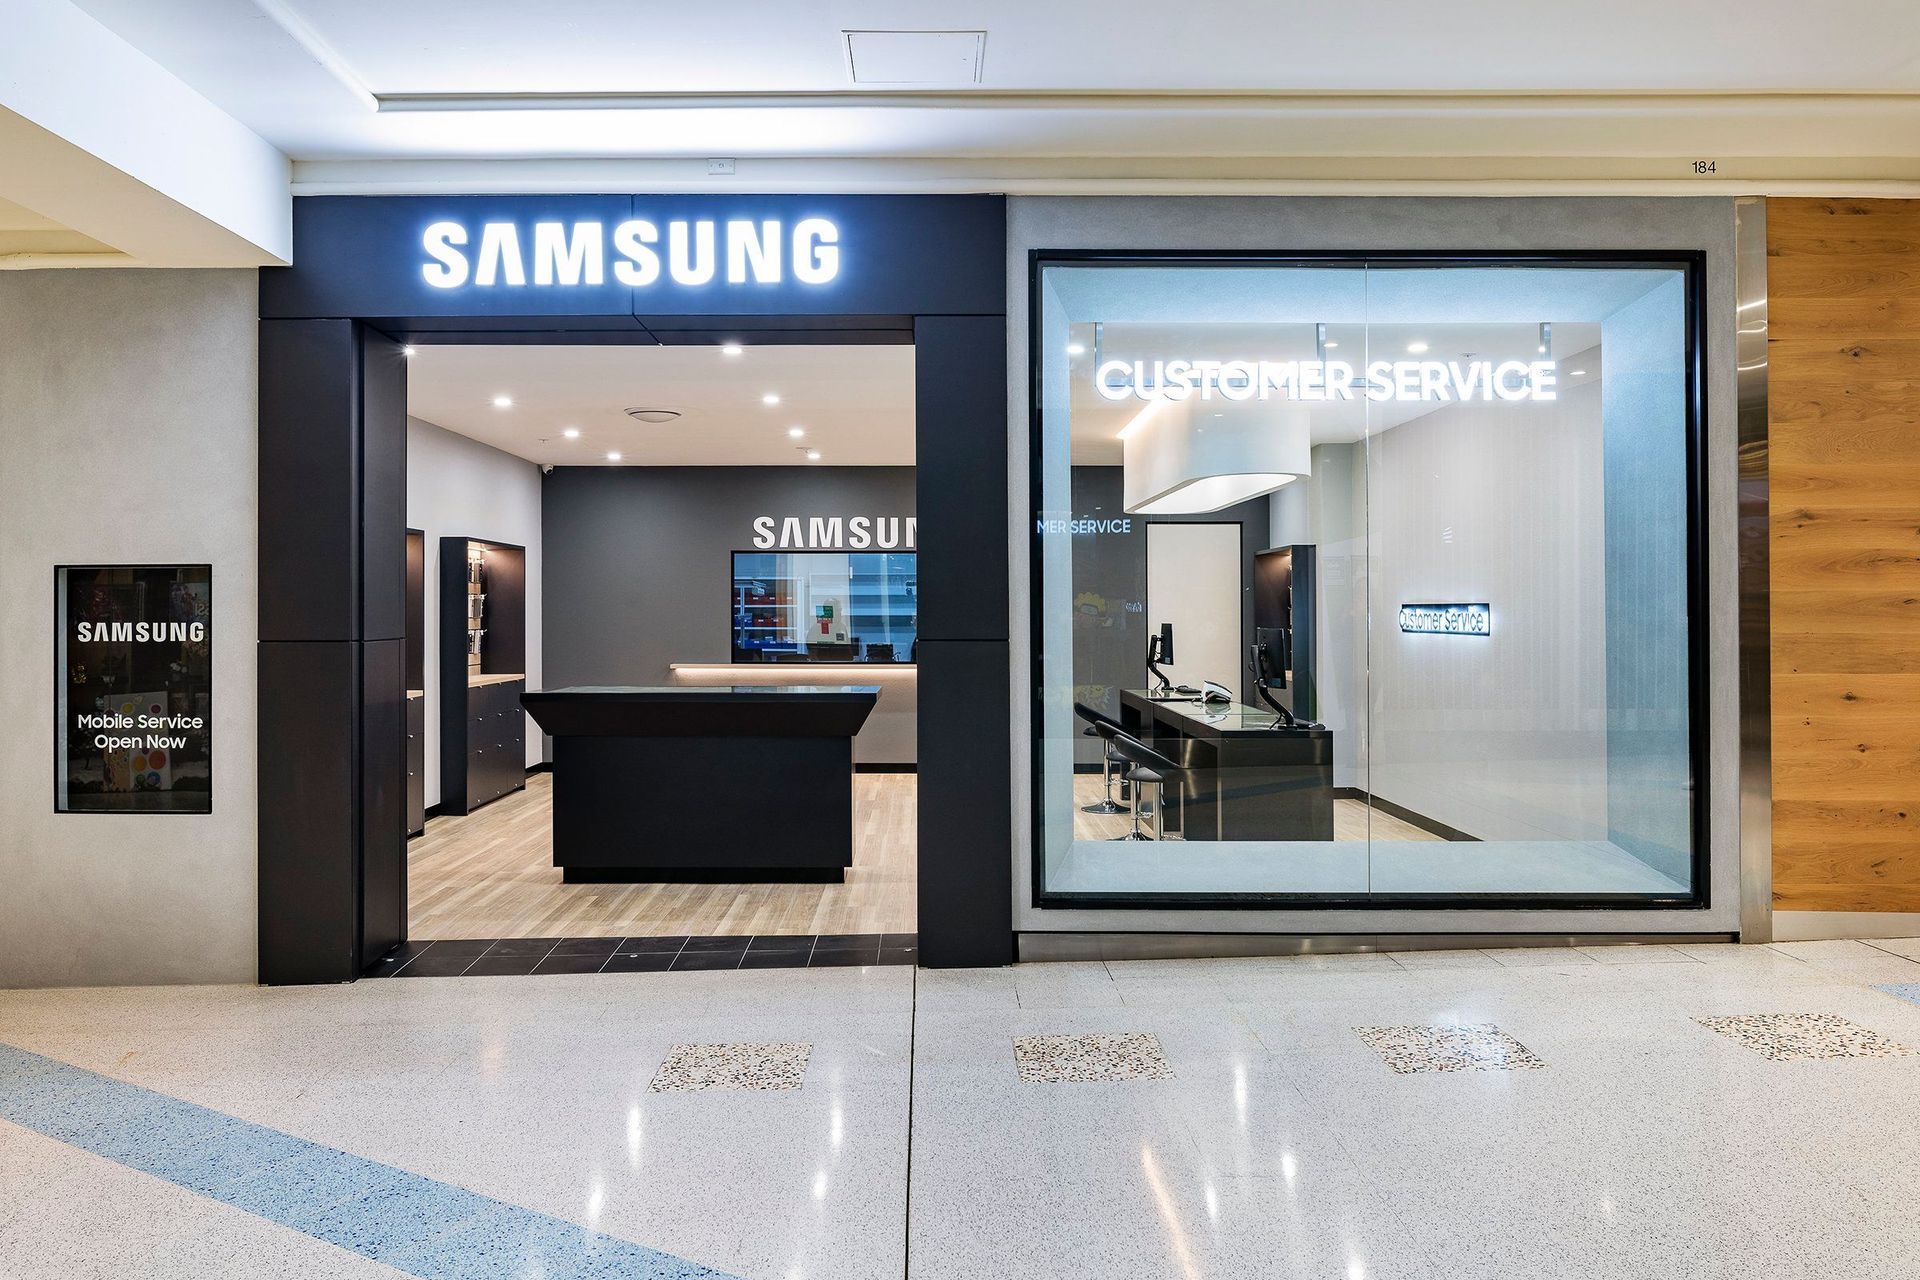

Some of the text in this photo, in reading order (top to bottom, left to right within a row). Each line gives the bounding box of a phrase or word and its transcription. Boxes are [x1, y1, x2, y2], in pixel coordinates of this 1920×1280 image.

[1691, 160, 1717, 174] 184
[421, 218, 840, 289] SAMSUNG
[1096, 360, 1557, 402] CUSTOMER SERVICE
[1071, 519, 1131, 534] SERVICE
[1398, 608, 1484, 632] Customer Service
[77, 621, 205, 643] SAMSUNG
[77, 713, 204, 730] Mobile Service
[94, 734, 187, 754] Open Now
